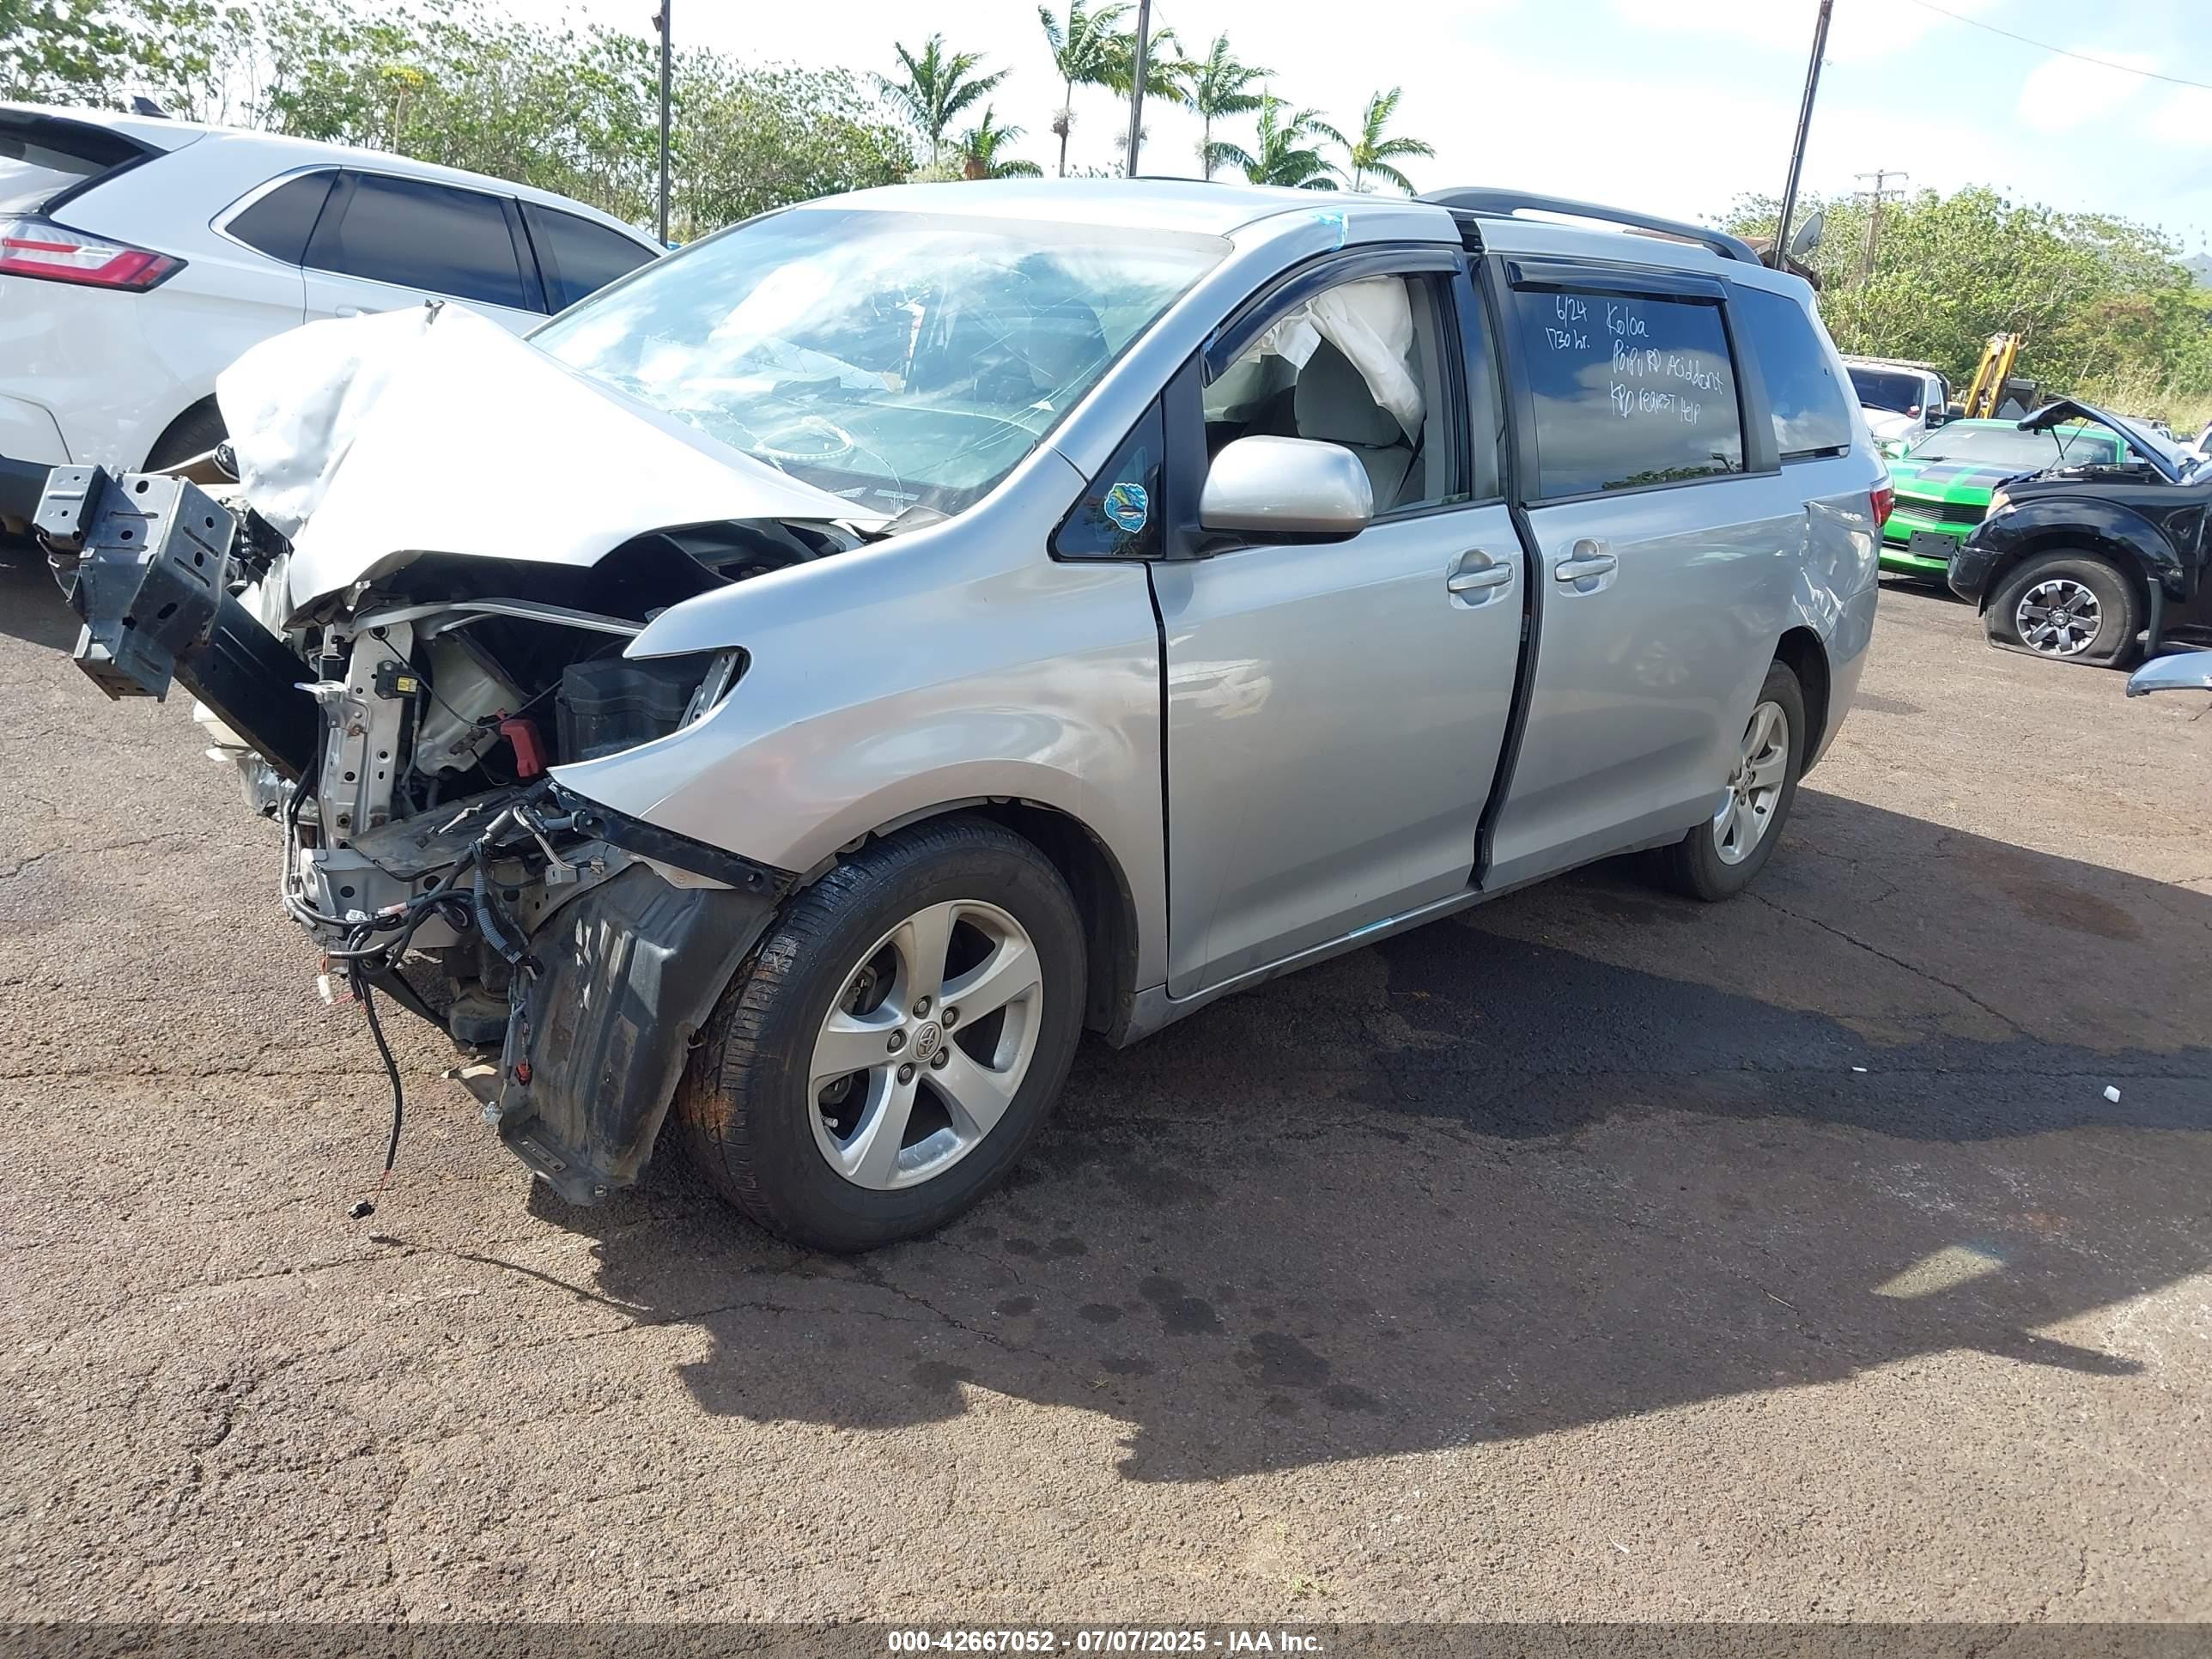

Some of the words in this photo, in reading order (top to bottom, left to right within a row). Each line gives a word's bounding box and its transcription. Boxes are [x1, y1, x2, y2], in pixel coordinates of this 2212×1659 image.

[1556, 295, 1588, 328] 6/24
[1606, 301, 1650, 337] Koloa
[1545, 326, 1571, 350] 1730
